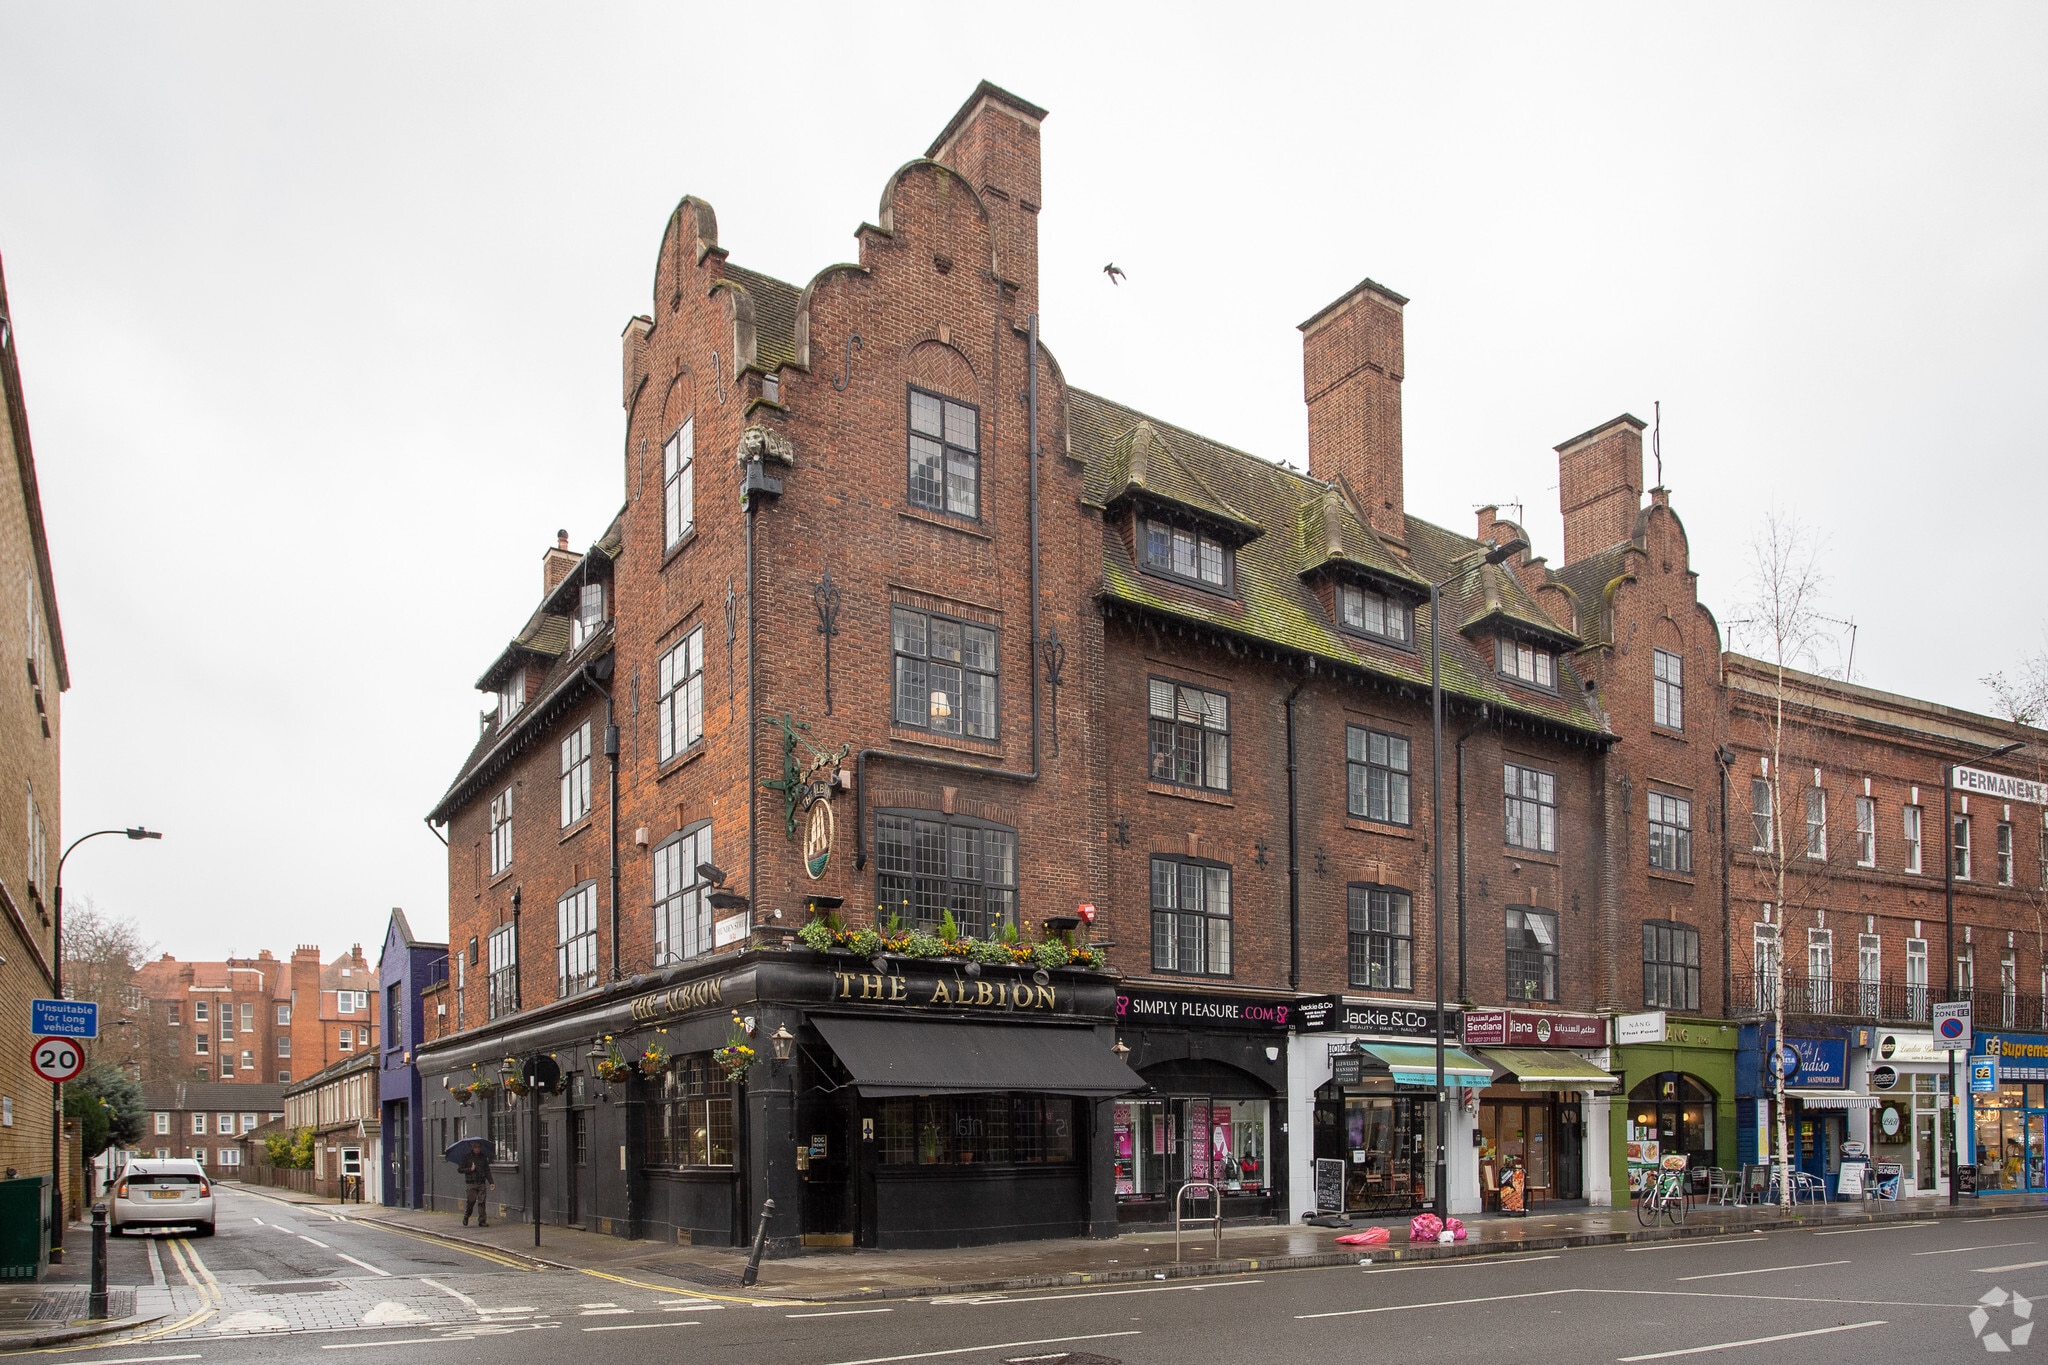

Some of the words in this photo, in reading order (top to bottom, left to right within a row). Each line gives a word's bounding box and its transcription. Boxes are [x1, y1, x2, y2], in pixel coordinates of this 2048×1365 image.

[1959, 769, 2041, 800] PERMANENT
[630, 993, 658, 1020] THE
[665, 976, 724, 1013] ALBION
[835, 971, 908, 1000] THE
[930, 979, 1056, 1009] ALBION
[37, 1003, 93, 1015] Unsuitable
[1133, 999, 1178, 1015] SIMPLY
[1298, 1003, 1318, 1011] Jackie
[1318, 1002, 1324, 1010] &
[43, 1013, 59, 1022] for
[62, 1015, 86, 1025] long
[1342, 1009, 1389, 1025] Jackie
[1391, 1011, 1404, 1026] &
[1406, 1012, 1427, 1027] Co
[43, 1023, 86, 1033] vehicles
[1467, 1022, 1502, 1031] Sendiana
[1900, 1043, 1921, 1053] London
[2002, 1041, 2048, 1059] Supreme
[40, 1050, 76, 1069] 20
